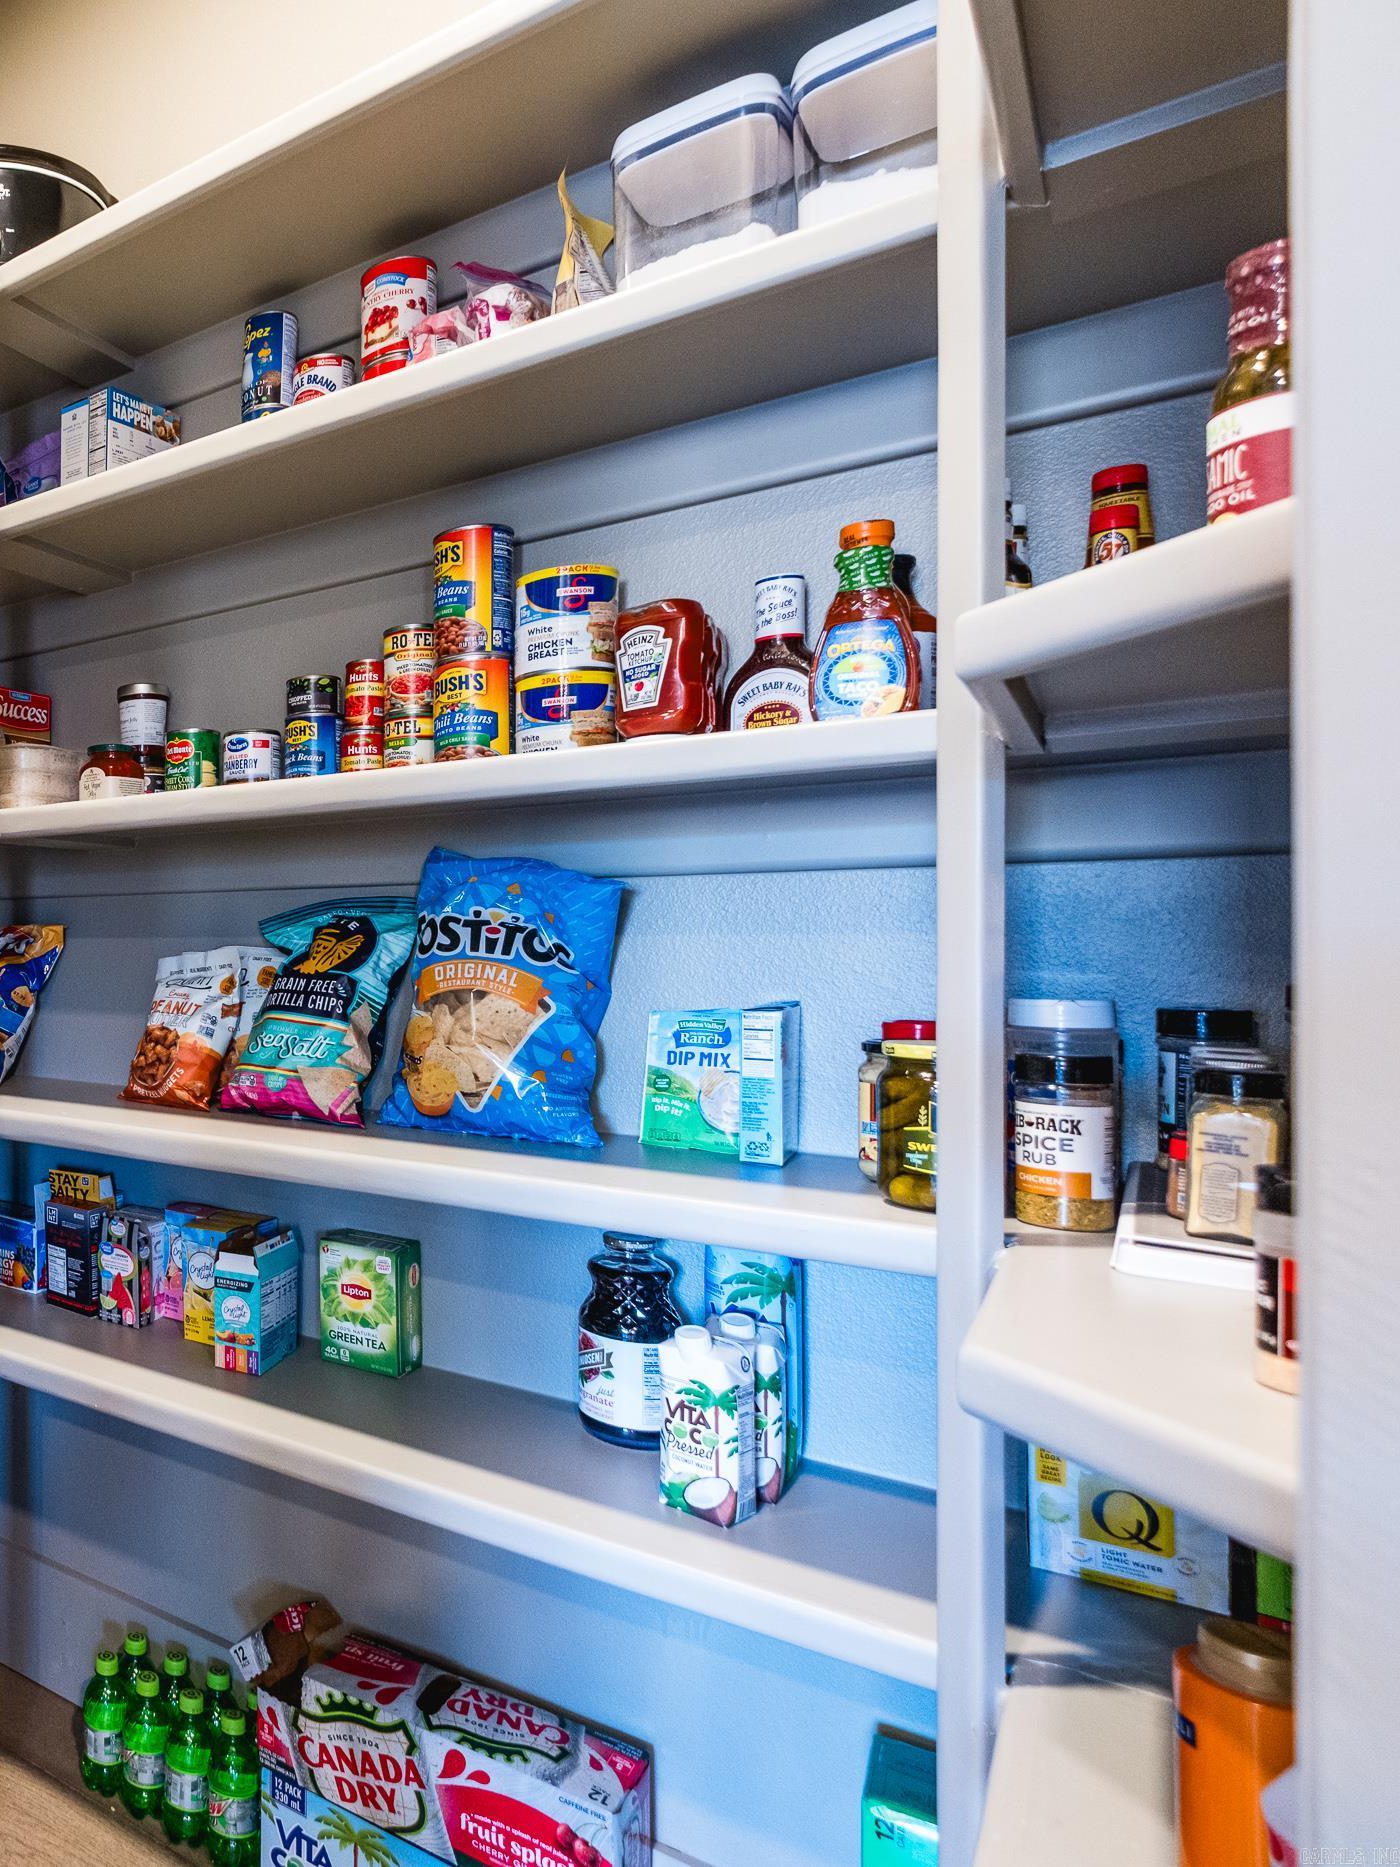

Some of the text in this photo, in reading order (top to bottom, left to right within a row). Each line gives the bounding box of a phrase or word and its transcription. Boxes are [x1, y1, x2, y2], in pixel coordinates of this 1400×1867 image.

[383, 288, 414, 299] CHERRY
[307, 374, 337, 393] BRAND
[113, 391, 130, 406] LET'S
[112, 401, 153, 432] HAPPEN
[437, 584, 469, 598] Beans
[557, 587, 594, 595] SWANSON
[768, 598, 793, 613] Sauce
[761, 607, 798, 627] the Boss!
[528, 625, 553, 636] White
[527, 637, 573, 652] CHICKEN
[627, 635, 654, 649] HEINZ
[827, 638, 895, 658] ORTEGA
[396, 651, 433, 660] Original
[528, 647, 565, 661] BREAST
[627, 648, 654, 661] TOMATO
[628, 656, 652, 666] KETCHUP
[631, 671, 649, 680] ADDED
[634, 664, 656, 673] SUGAR
[434, 672, 485, 698] BUSH'S
[838, 680, 878, 693] TACO
[447, 692, 462, 700] BEST
[738, 680, 807, 707] SWEET BABY RAY'S
[454, 713, 494, 725] Beans
[748, 715, 798, 729] Brown Sugar
[753, 709, 791, 721] Hickory &
[436, 727, 454, 737] PINTO
[521, 735, 540, 743] White
[297, 752, 323, 762] Beans
[366, 757, 381, 765] Paste
[434, 965, 518, 988] ORIGINAL
[275, 977, 337, 994] GRAIN FREE
[439, 979, 513, 994] RESTAURANT STYLE
[307, 995, 344, 1014] CHIPS
[680, 1021, 723, 1030] Hidden Valley
[249, 1031, 284, 1054] sea
[680, 1032, 725, 1045] Ranch
[667, 1050, 731, 1068] DIP MIX
[159, 1067, 185, 1098] NUGGETS
[1035, 1117, 1082, 1136] RACK
[1015, 1134, 1075, 1153] SPICE
[1022, 1150, 1057, 1167] RUB
[49, 1171, 79, 1187] STAY
[1019, 1171, 1063, 1187] CHICKEN
[50, 1185, 89, 1200] SALTY
[216, 1278, 248, 1288] ENERGIZING
[343, 1285, 369, 1298] Lipton
[328, 1329, 387, 1352] GREEN TEA
[353, 1329, 378, 1338] NATURAL
[325, 1345, 337, 1354] 40
[665, 1397, 710, 1429] VITA
[666, 1432, 715, 1460] Pressed
[672, 1453, 713, 1471] COCONUT WATER
[1091, 1489, 1163, 1551] Q
[1101, 1547, 1128, 1557] LIGHT
[1102, 1555, 1163, 1573] TONIC WATER
[234, 1646, 247, 1665] 12
[462, 1688, 534, 1718] DRY
[328, 1734, 380, 1750] SINCE 1904
[298, 1733, 427, 1790] CANADA
[274, 1776, 302, 1800] 12 PACK
[334, 1776, 397, 1814] DRY
[274, 1789, 302, 1812] 330 mL
[588, 1788, 609, 1806] 12
[558, 1796, 590, 1815] CAFFEINE
[460, 1812, 506, 1849] fruit
[474, 1814, 492, 1824] made
[492, 1819, 506, 1829] with
[511, 1827, 532, 1841] splash
[532, 1834, 540, 1843] of
[540, 1839, 552, 1850] real
[876, 1817, 896, 1842] 12
[276, 1818, 334, 1867] VITA
[472, 1840, 509, 1863] CHERRY
